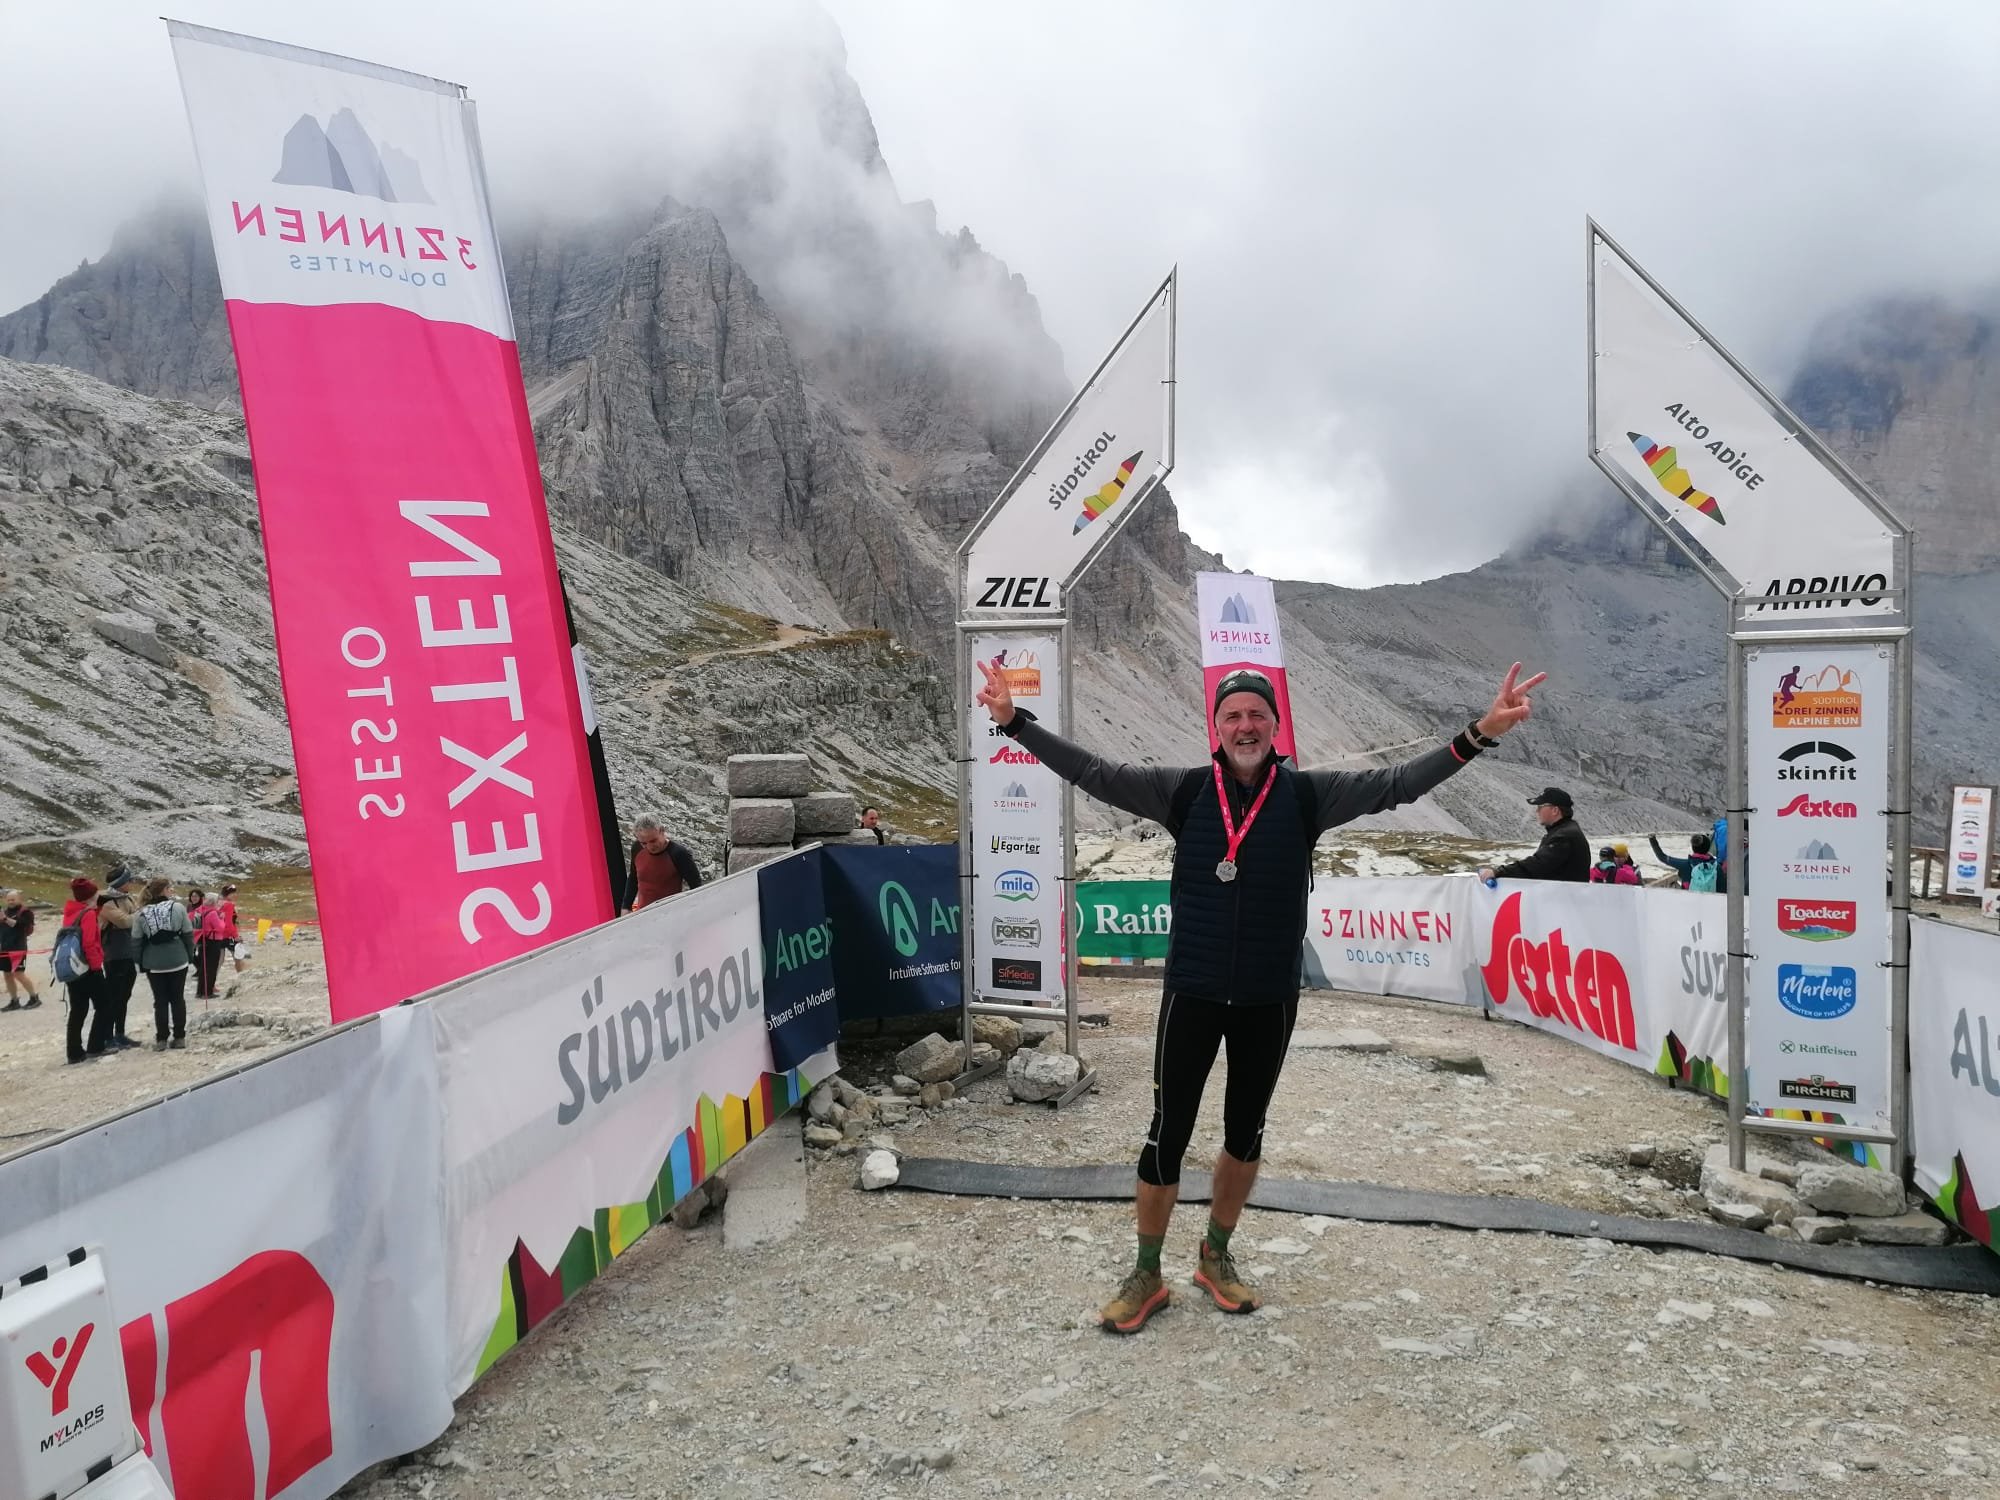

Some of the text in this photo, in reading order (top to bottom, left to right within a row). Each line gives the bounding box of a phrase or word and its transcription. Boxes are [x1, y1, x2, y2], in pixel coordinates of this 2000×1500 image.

[976, 577, 1051, 608] ZIEL
[1757, 573, 1888, 612] ARRIVO
[1785, 706, 1859, 715] DREI ZINNEN
[1788, 717, 1859, 725] ALPINE RUN
[1777, 766, 1857, 780] skinfit
[1777, 793, 1857, 818] Sexten
[1001, 841, 1040, 853] Egarter
[1001, 877, 1033, 891] mila
[1784, 904, 1851, 921] Loacker
[996, 924, 1037, 940] FORST
[1346, 948, 1431, 968] DOLOMITES
[1481, 891, 1637, 1051] Sexten
[1782, 975, 1852, 1004] Marlene
[766, 1006, 793, 1031] oftware
[794, 1000, 805, 1016] for
[1799, 1044, 1857, 1057] Raiffeisen
[1786, 1084, 1850, 1099] PIRCHER
[40, 1404, 105, 1453] MYLAPS
